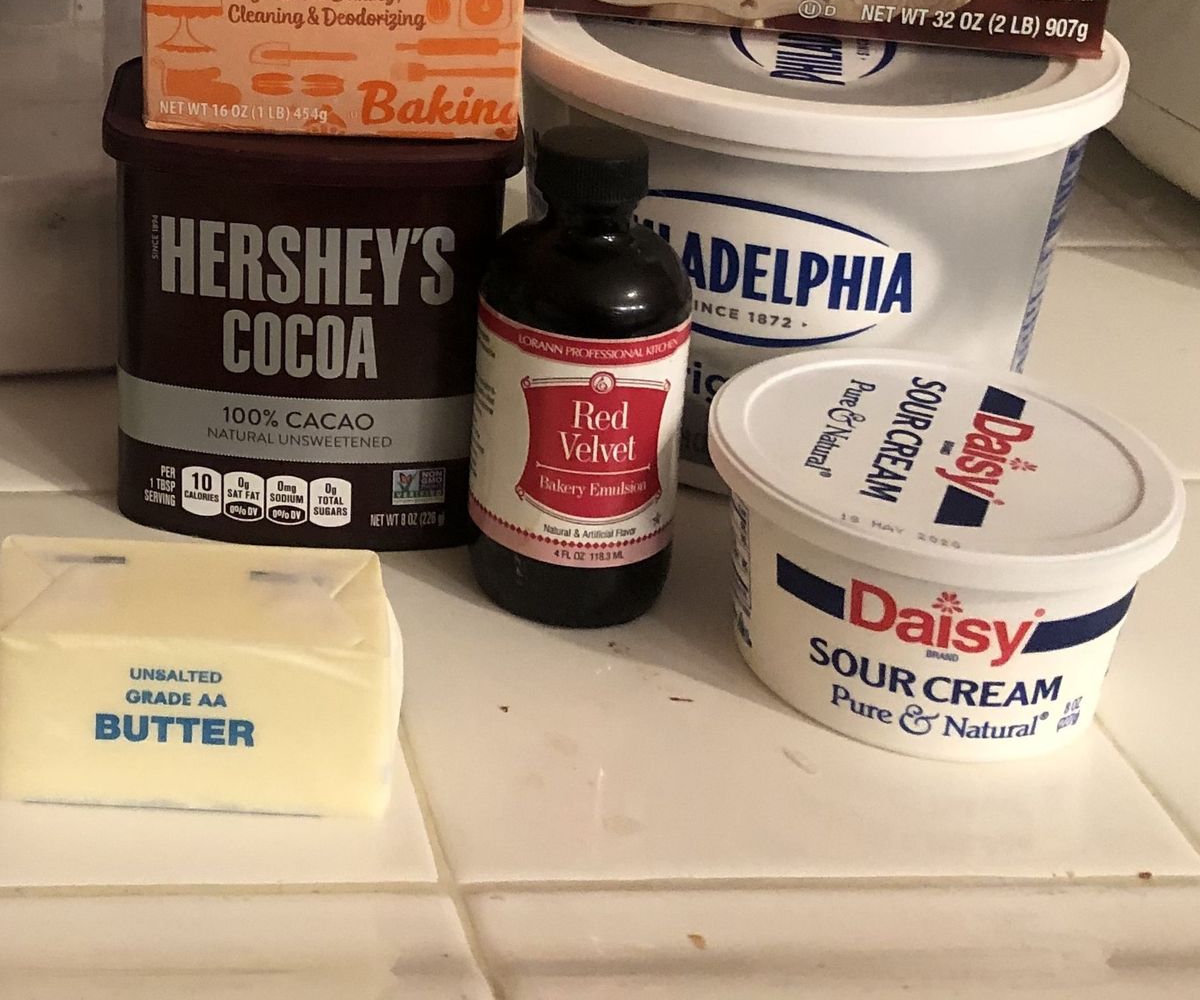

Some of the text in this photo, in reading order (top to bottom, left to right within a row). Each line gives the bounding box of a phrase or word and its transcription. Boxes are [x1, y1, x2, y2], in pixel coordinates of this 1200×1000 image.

[228, 3, 427, 31] Cleaning & Deodorizing
[861, 4, 1090, 43] NET WT 32 OZ (2 LB) 907g
[159, 99, 328, 123] NET WT 16 OZ (1 LB) 454g
[160, 215, 457, 306] HERSHEY'S
[693, 299, 792, 329] INCE 1872
[222, 308, 379, 380] COCOA
[517, 332, 564, 355] LORANN
[565, 344, 643, 360] PROFESSIONAL
[222, 406, 375, 431] 100% CACAO
[572, 400, 629, 431] Red
[804, 378, 877, 475] Pure & Natural
[207, 426, 393, 449] NATURAL UNSWEETENED
[557, 430, 637, 464] Velvet
[859, 376, 948, 504] SOUR CREAM
[935, 411, 1036, 499] Daisy
[161, 464, 176, 479] PER
[191, 472, 213, 492] 10
[237, 476, 250, 490] 0g
[144, 488, 176, 507] SERVING
[156, 478, 176, 494] TBSP
[184, 490, 220, 504] CALORIES
[227, 488, 261, 501] SAT FAT
[277, 480, 297, 494] 0mg
[325, 482, 337, 496] 0g
[539, 474, 648, 499] Bakery Emulsion
[269, 493, 304, 504] SODIUM
[318, 495, 345, 506] TOTAL
[313, 506, 348, 517] SUGARS
[370, 513, 399, 527] NET WT
[543, 523, 637, 538] Natural Artificial Flavor
[573, 551, 585, 560] OZ
[849, 577, 1041, 667] Daisy
[926, 650, 959, 662] BRAND
[130, 667, 223, 684] UNSALTED
[809, 636, 1063, 707] SOUR CREAM
[125, 689, 227, 708] GRADE AA
[831, 684, 893, 725] Pure
[898, 704, 940, 735] &
[943, 715, 1038, 740] Natural
[95, 713, 255, 748] BUTTER
